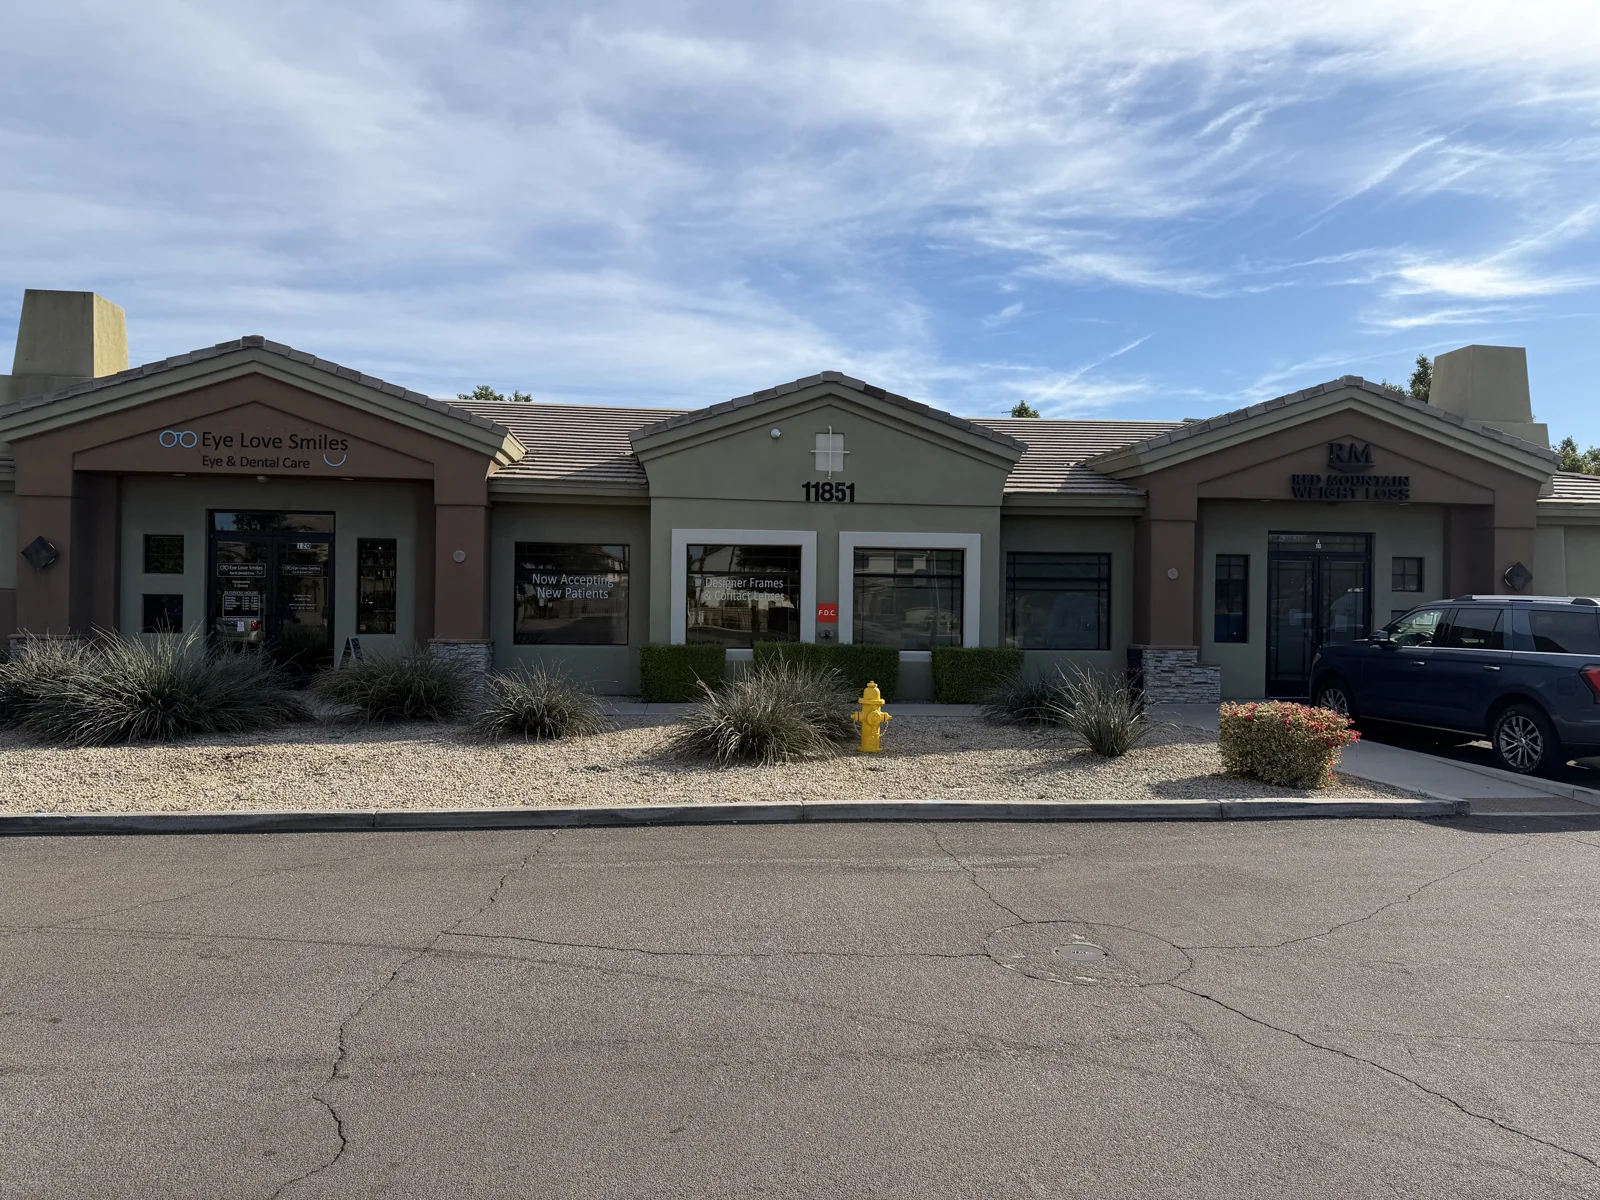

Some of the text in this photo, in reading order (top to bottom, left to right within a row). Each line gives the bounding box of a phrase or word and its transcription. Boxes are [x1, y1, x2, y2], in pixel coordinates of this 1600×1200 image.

[202, 431, 349, 451] Eye Love Smiles
[1327, 442, 1375, 464] RM
[202, 455, 310, 469] Eye & Dental Care
[1325, 474, 1410, 487] MOUNTAIN
[801, 481, 855, 503] 11851
[1364, 487, 1410, 500] LOSS
[532, 573, 558, 584] Now
[705, 577, 784, 590] Designer Frames
[537, 587, 609, 599] New Patients
[703, 591, 785, 601] & Contact Lenses
[818, 609, 836, 617] F.D.C.
